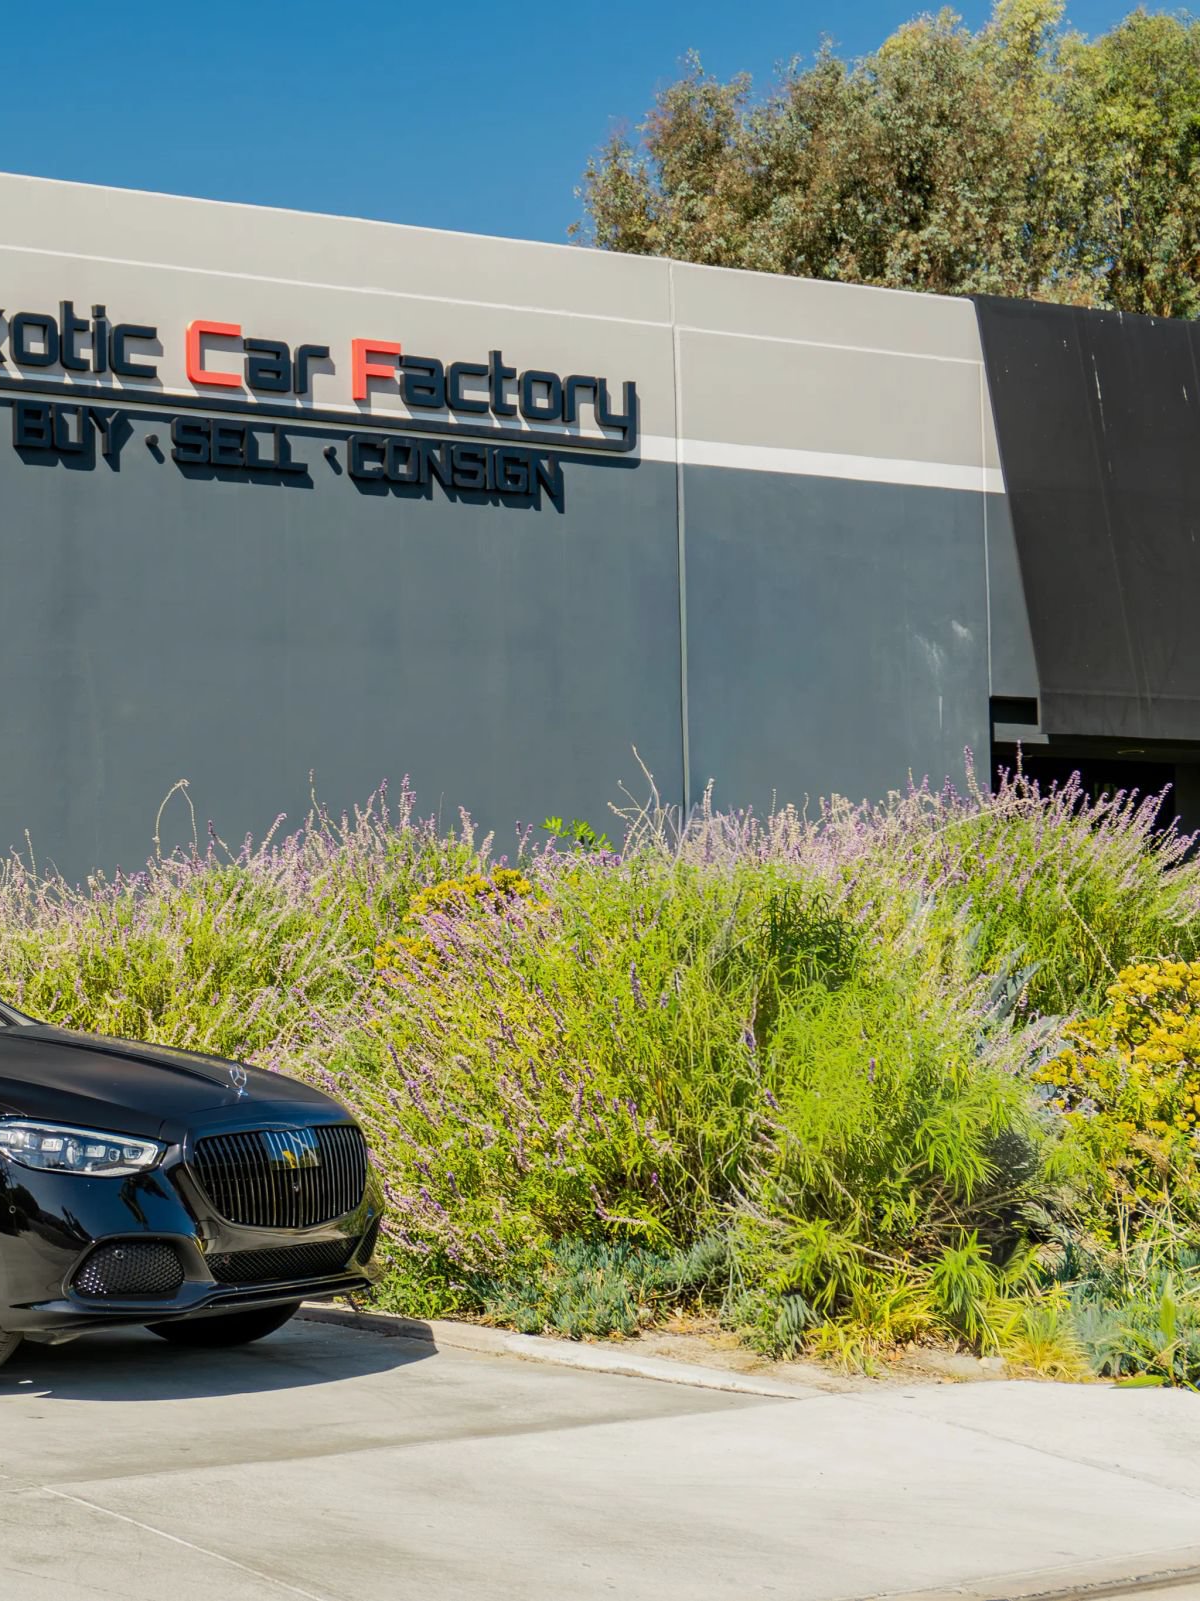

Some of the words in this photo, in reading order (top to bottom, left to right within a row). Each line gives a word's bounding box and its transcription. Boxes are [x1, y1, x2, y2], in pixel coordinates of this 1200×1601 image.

[186, 320, 330, 394] Car
[351, 338, 636, 451] Factory
[12, 400, 121, 454] BUY
[171, 416, 308, 473] SELL
[347, 434, 559, 498] CONSIGN
